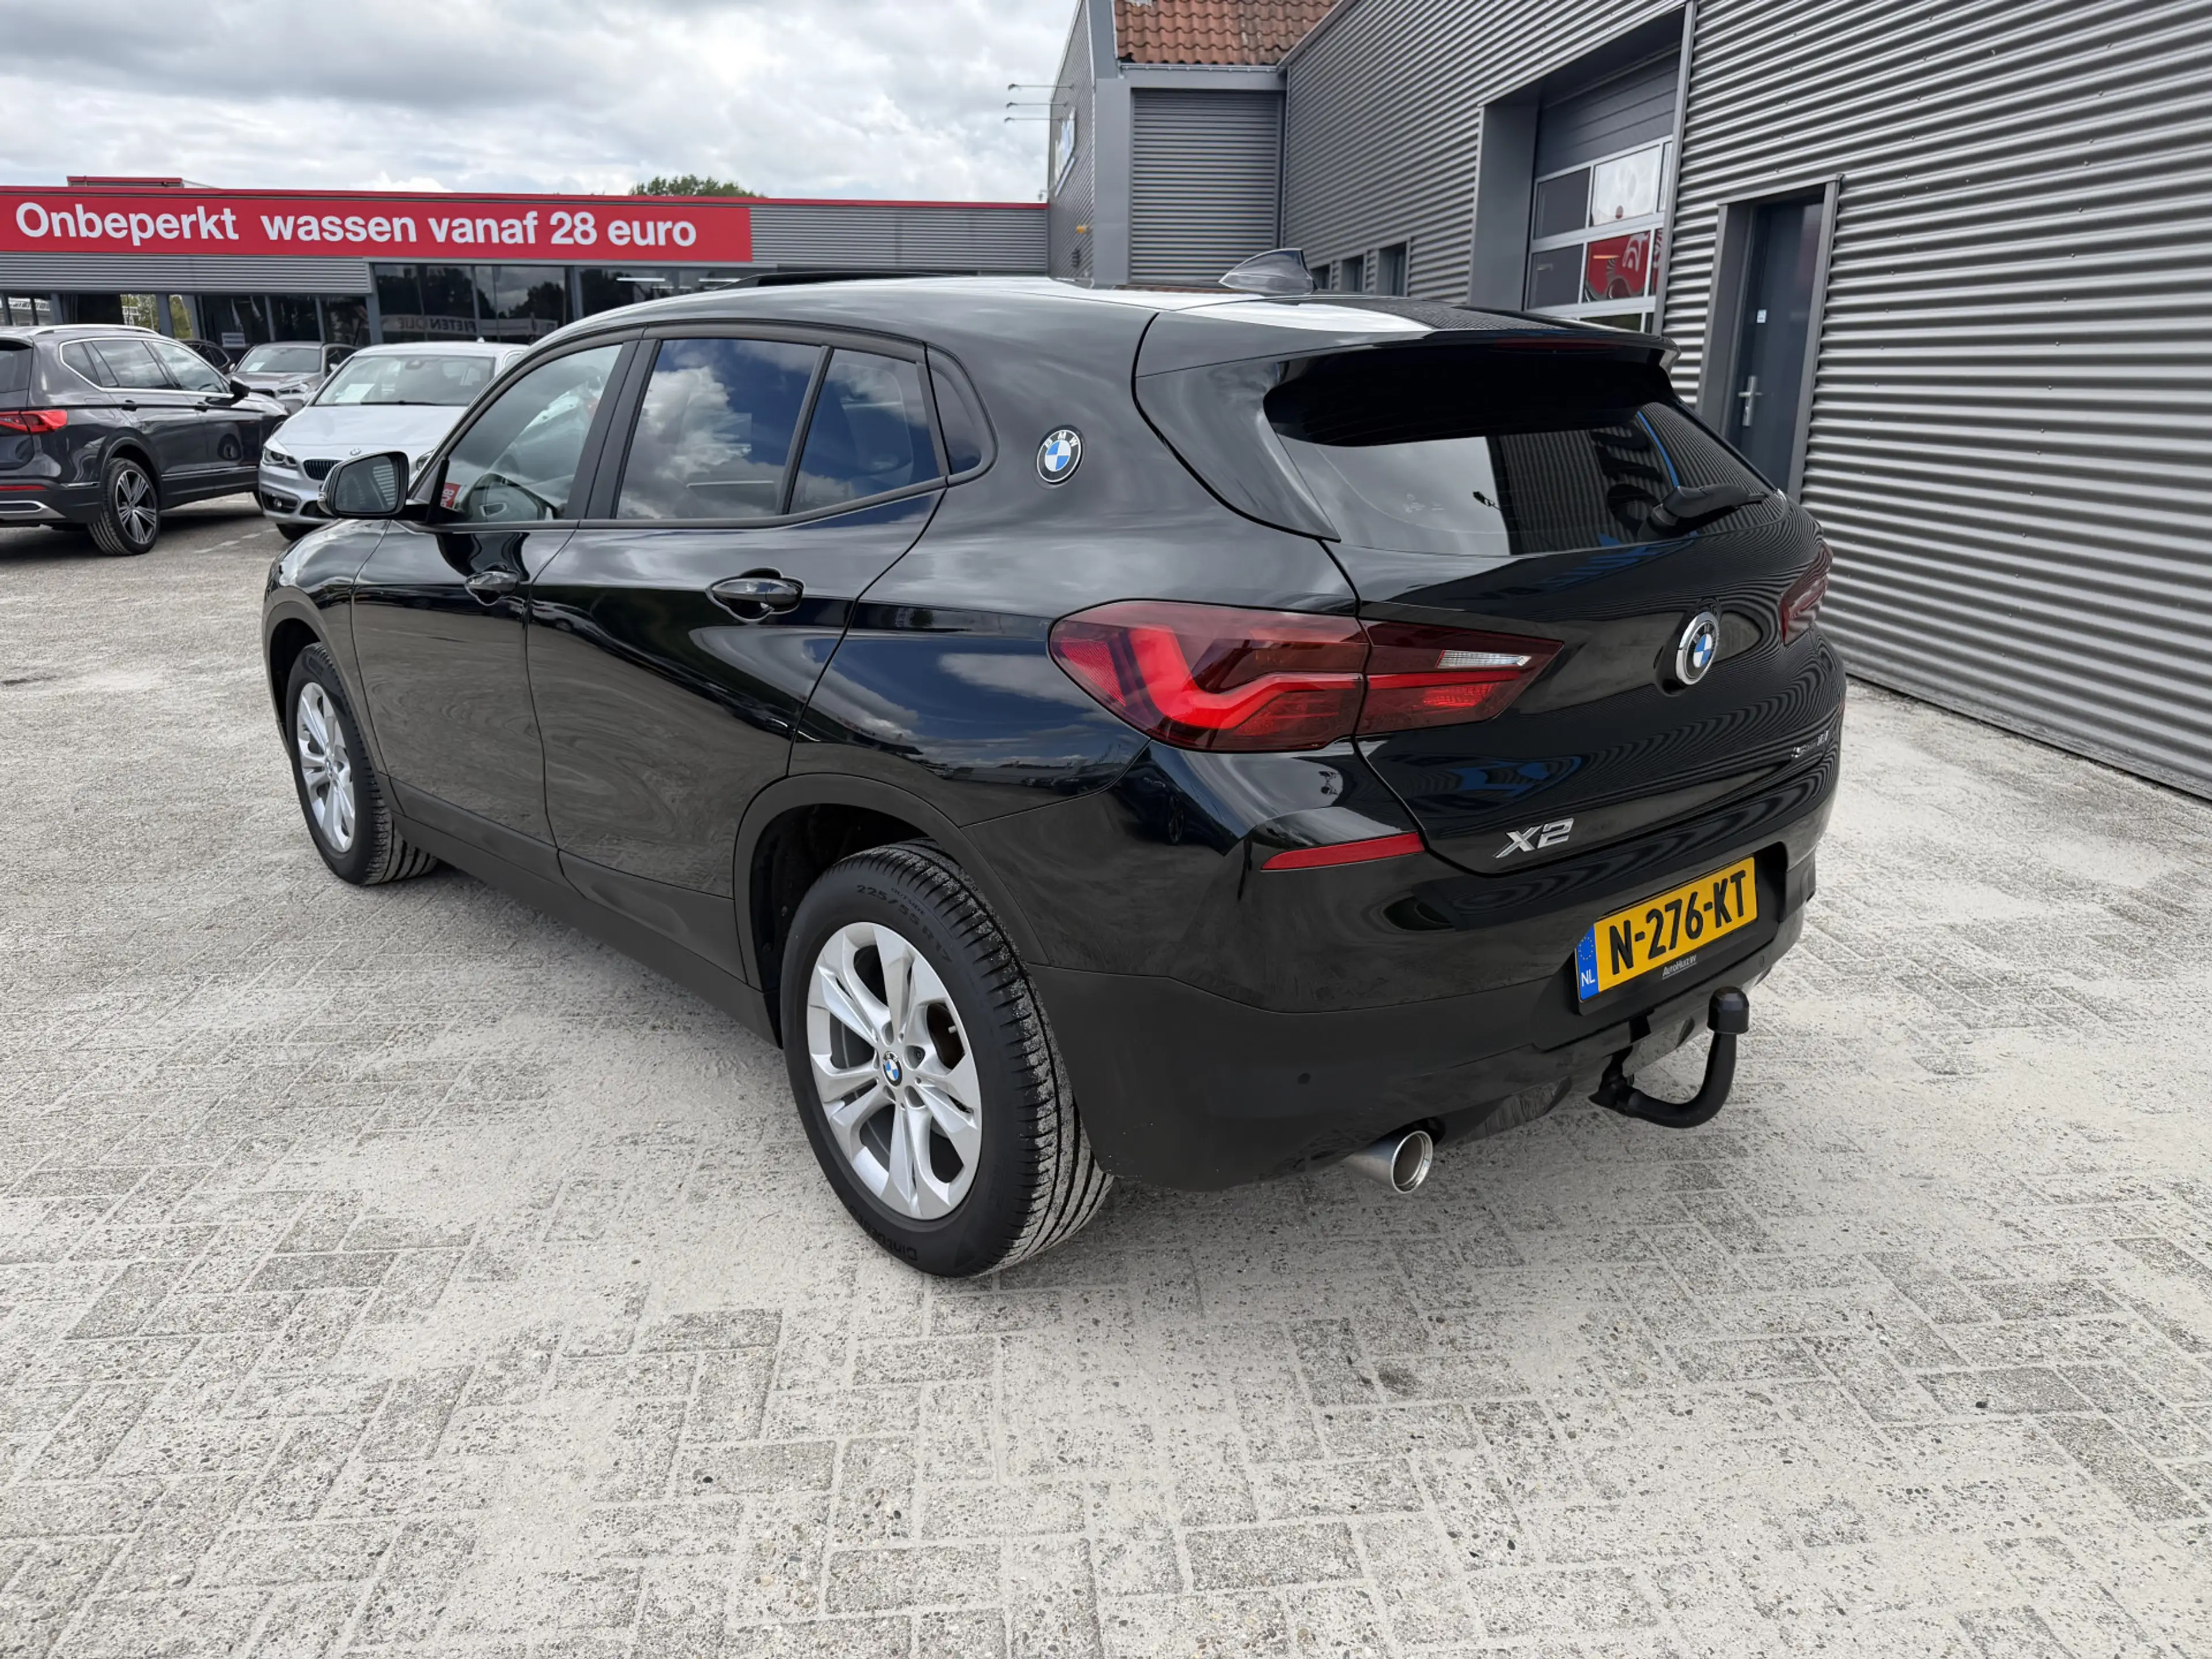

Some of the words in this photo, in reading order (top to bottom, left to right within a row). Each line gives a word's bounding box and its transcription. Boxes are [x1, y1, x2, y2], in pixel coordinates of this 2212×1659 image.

[16, 202, 238, 246] Onbeperkt
[260, 214, 416, 241] wassen
[428, 211, 538, 244] vanaf
[550, 211, 597, 245] 28
[608, 219, 696, 247] euro
[1045, 431, 1078, 448] BMW
[1493, 818, 1574, 858] X2
[1609, 870, 1746, 975] N-276-KT
[1581, 969, 1595, 986] NL
